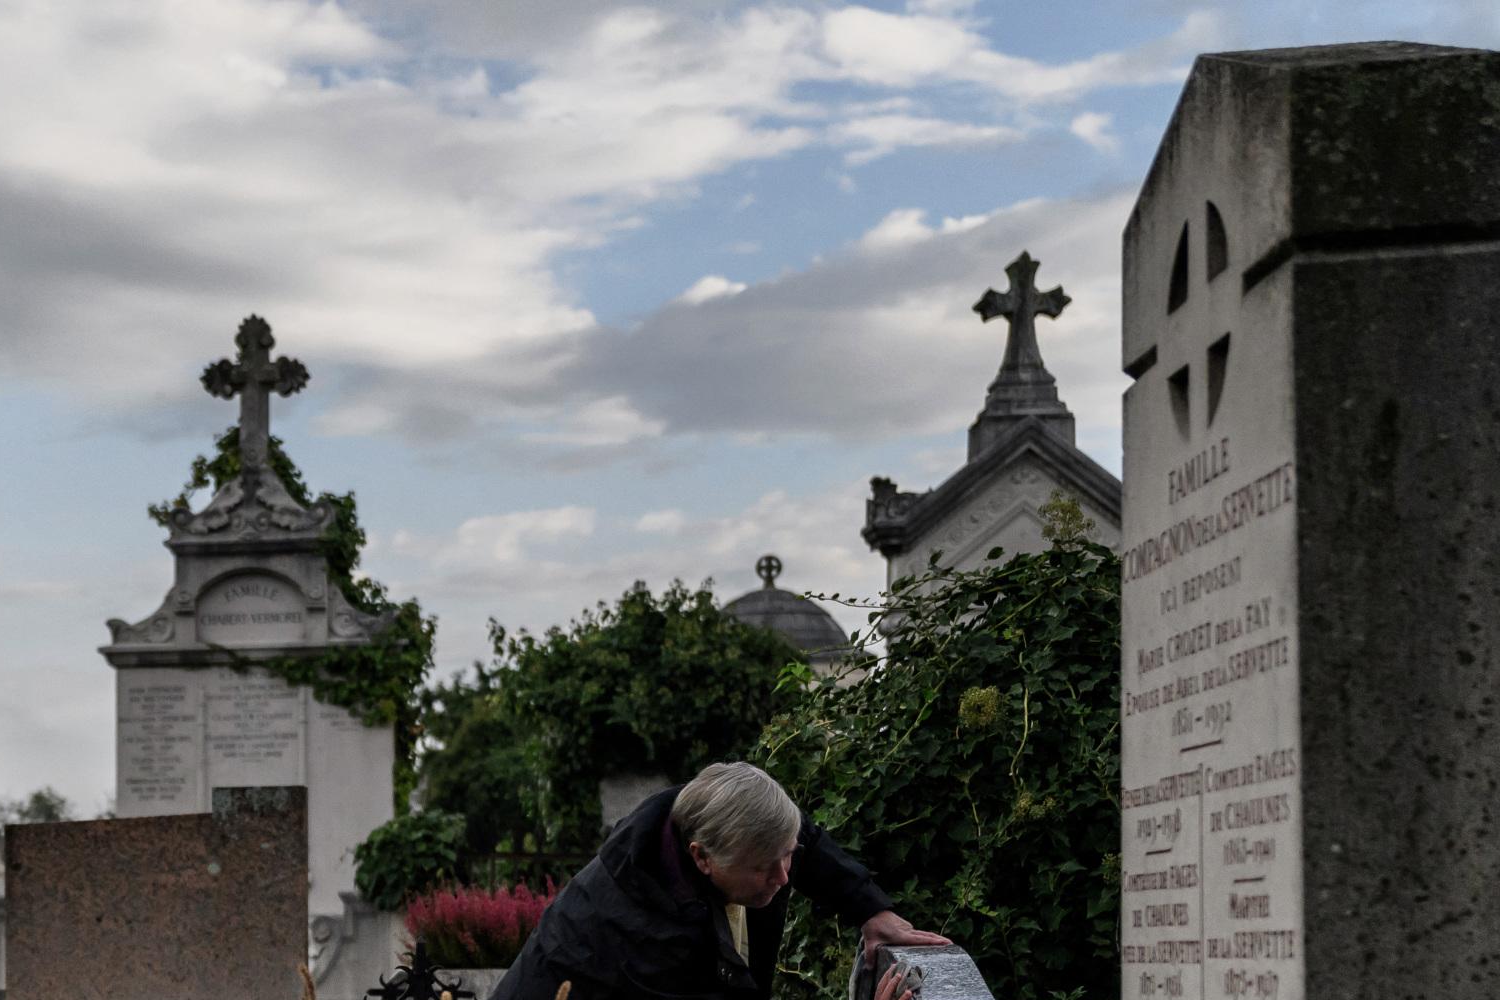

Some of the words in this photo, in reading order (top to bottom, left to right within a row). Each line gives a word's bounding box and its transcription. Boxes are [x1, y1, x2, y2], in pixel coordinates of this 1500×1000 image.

[1168, 436, 1229, 504] FAMILLE
[1123, 515, 1195, 583] COMPAGNON
[1221, 462, 1292, 533] SERVETTE
[1160, 584, 1177, 615] ICI
[1182, 555, 1241, 604] REPOSENT
[1137, 641, 1163, 674] MARIE
[1162, 683, 1174, 704] DE
[1201, 669, 1214, 691] DE
[1215, 665, 1227, 687] LA
[1227, 636, 1289, 682] SERVETTE
[1159, 770, 1200, 800] SERVETTE
[1241, 764, 1254, 785] DE
[1210, 811, 1222, 831] DE
[1159, 871, 1167, 888] DE
[1132, 910, 1142, 927] DE
[1228, 890, 1269, 919] MARTHE
[1137, 945, 1145, 961] DE
[1156, 940, 1201, 961] SERVETTE
[1207, 938, 1219, 957] DE
[1220, 938, 1232, 957] LA
[1233, 930, 1294, 956] SERVETTE
